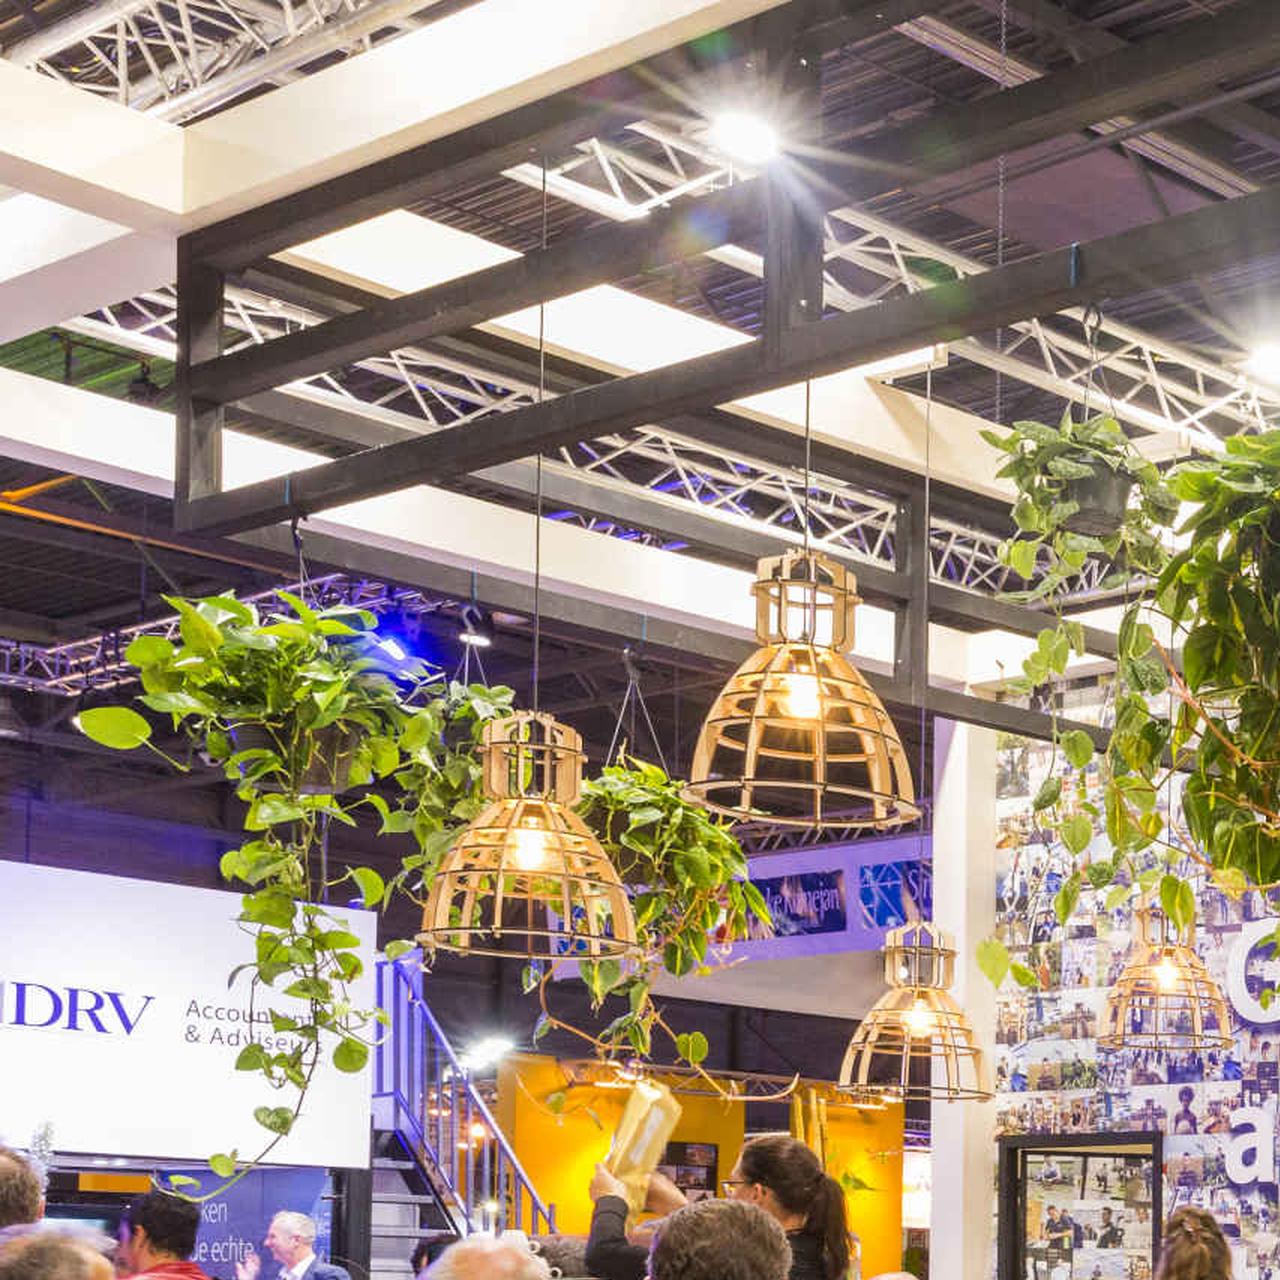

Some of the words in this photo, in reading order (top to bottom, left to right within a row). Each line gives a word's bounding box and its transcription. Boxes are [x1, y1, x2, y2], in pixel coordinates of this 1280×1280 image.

[10, 981, 155, 1036] DRV
[184, 1024, 201, 1044] &
[1225, 1106, 1274, 1184] a
[201, 1201, 228, 1224] ken
[210, 1235, 254, 1263] echte
